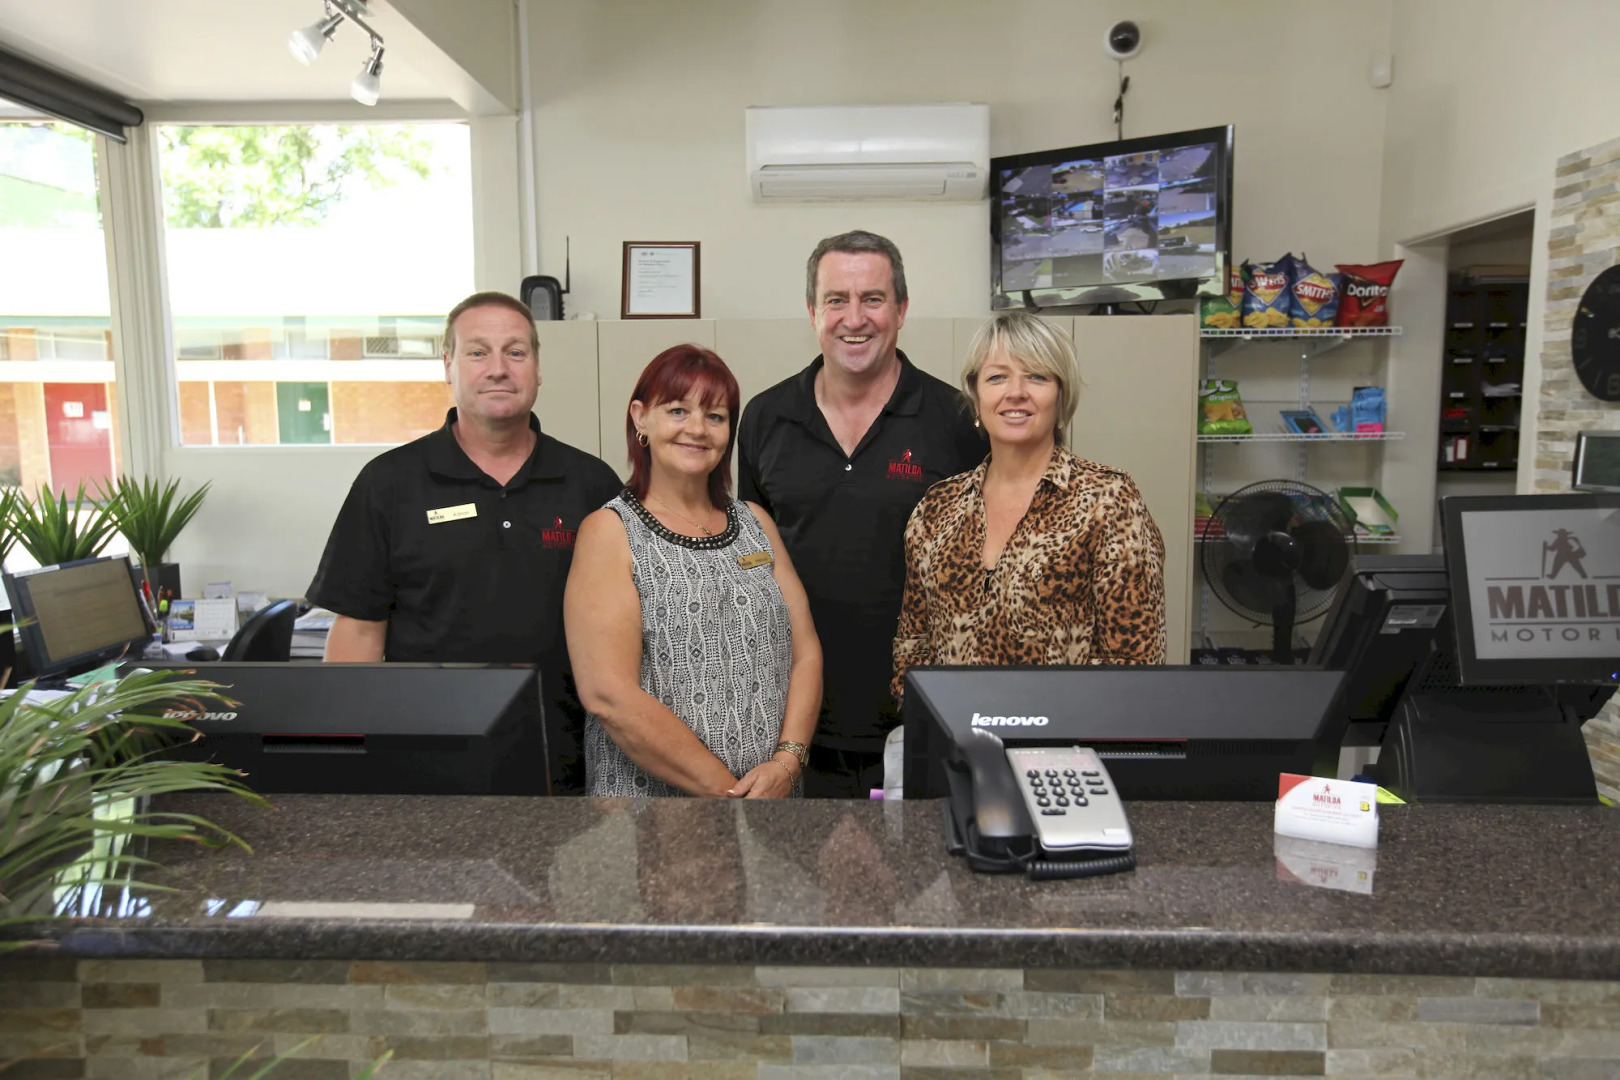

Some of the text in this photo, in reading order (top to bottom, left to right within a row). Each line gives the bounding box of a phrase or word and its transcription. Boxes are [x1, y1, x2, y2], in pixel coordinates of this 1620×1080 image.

[889, 463, 922, 475] MATILDA
[1491, 628, 1601, 642] MOTOR
[971, 712, 1049, 726] lenovo
[1312, 794, 1341, 805] MATILDA
